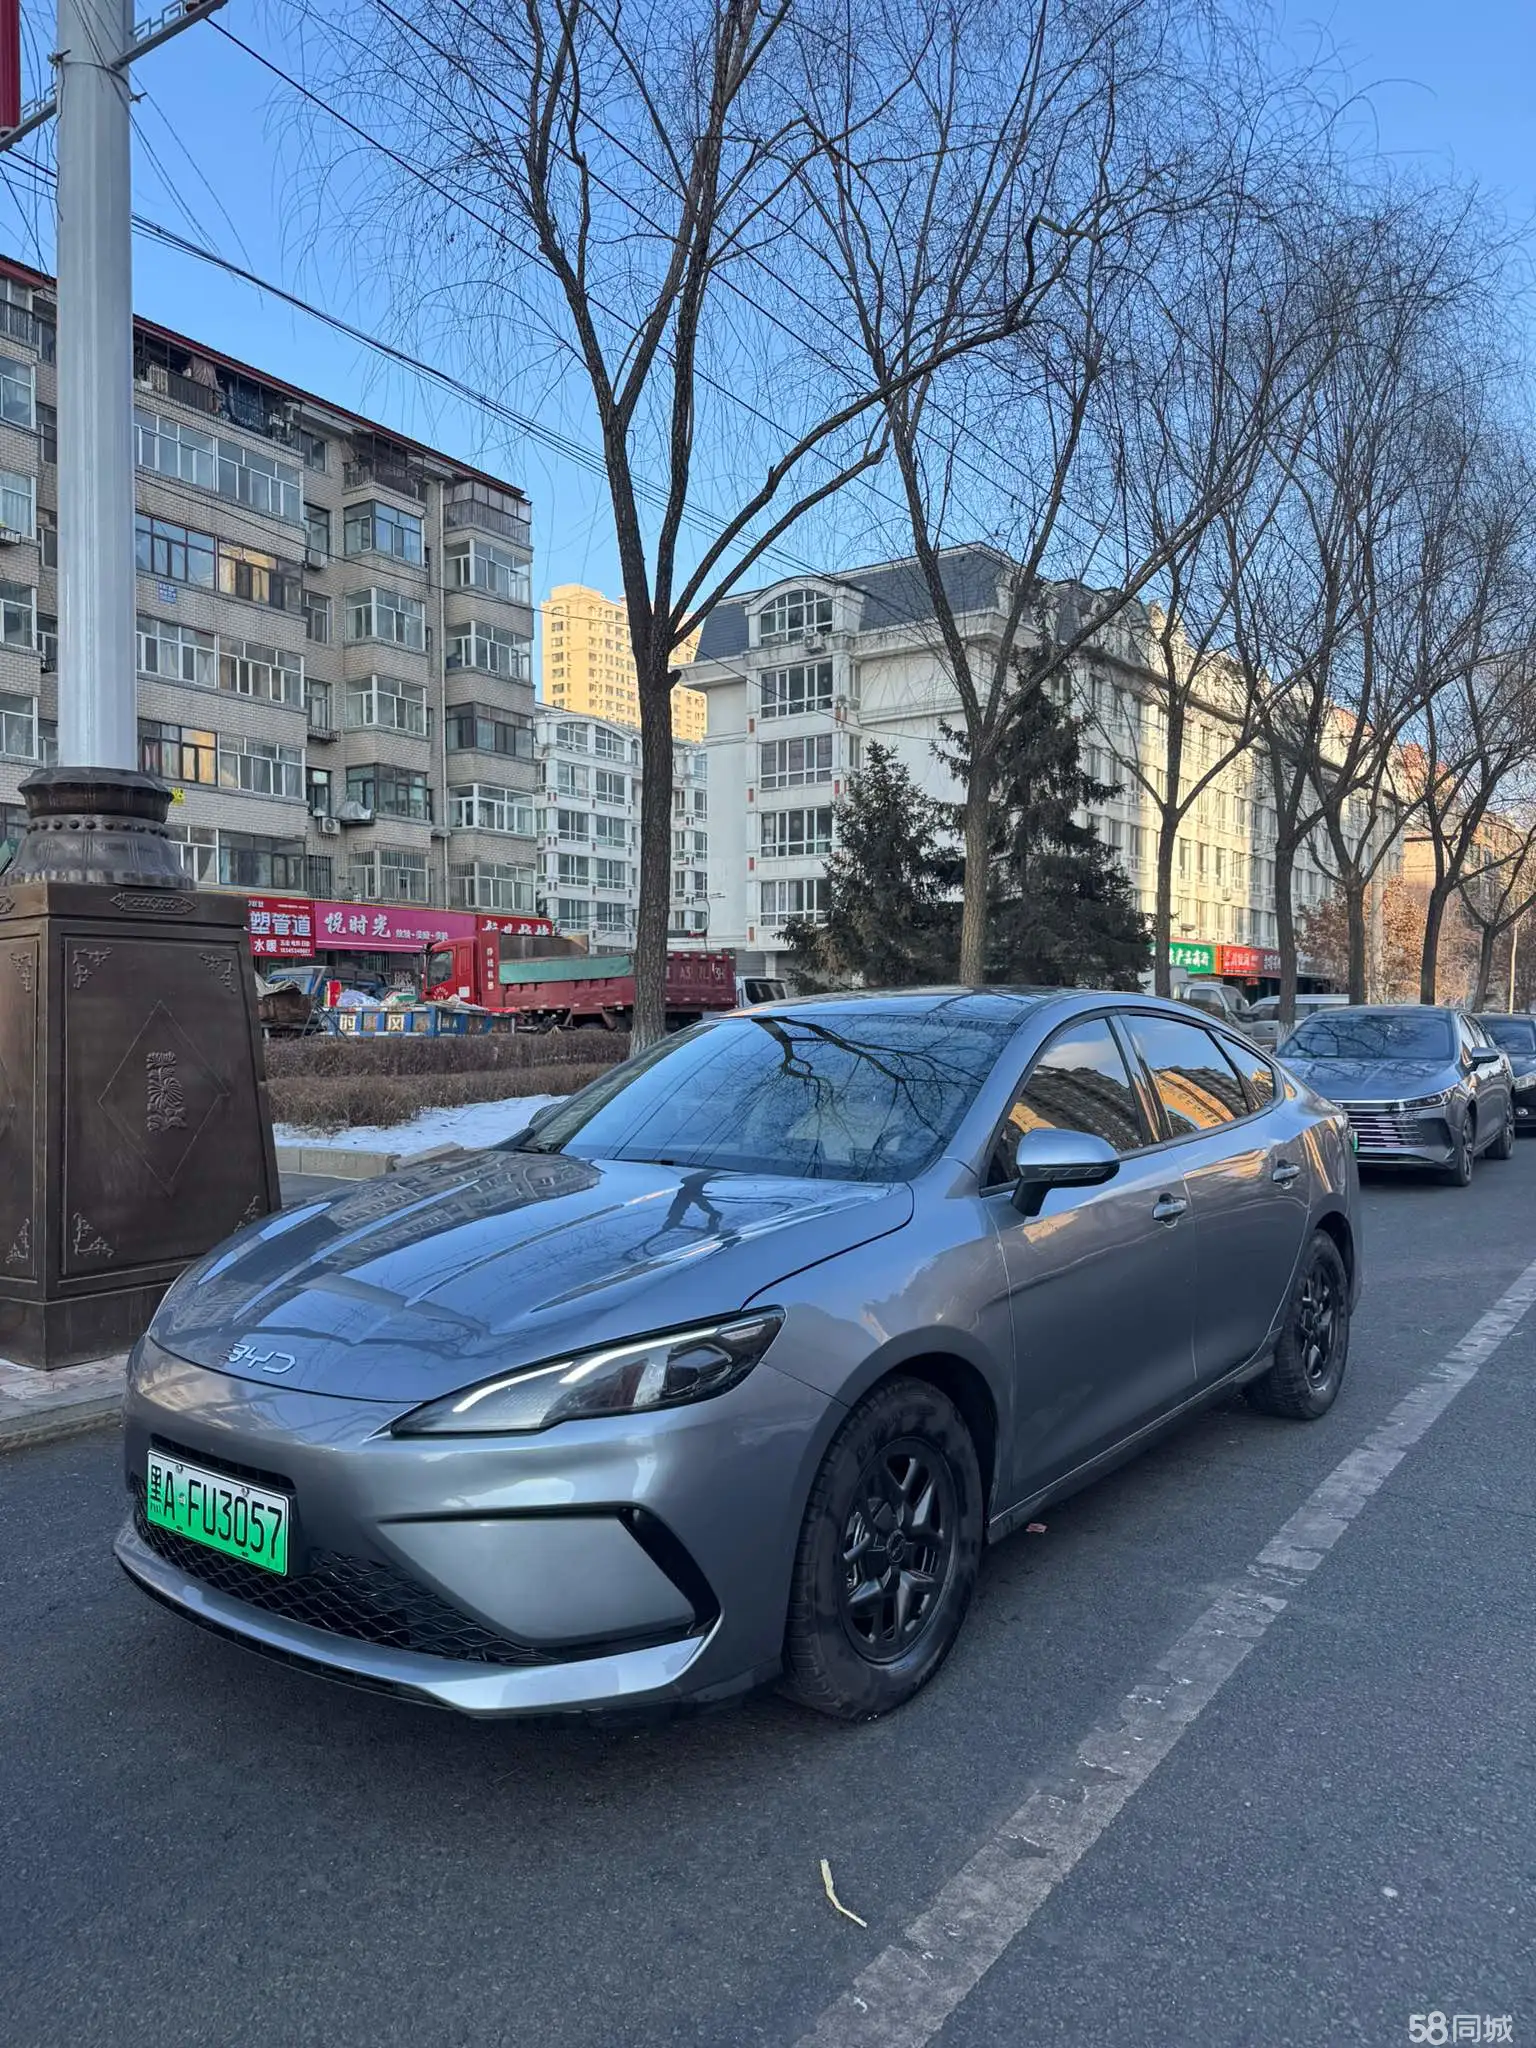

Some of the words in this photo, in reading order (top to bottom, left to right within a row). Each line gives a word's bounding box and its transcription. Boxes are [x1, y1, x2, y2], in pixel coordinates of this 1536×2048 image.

[324, 911, 391, 938] 悦时光
[254, 939, 277, 953] 水暖
[227, 1343, 296, 1374] BYD
